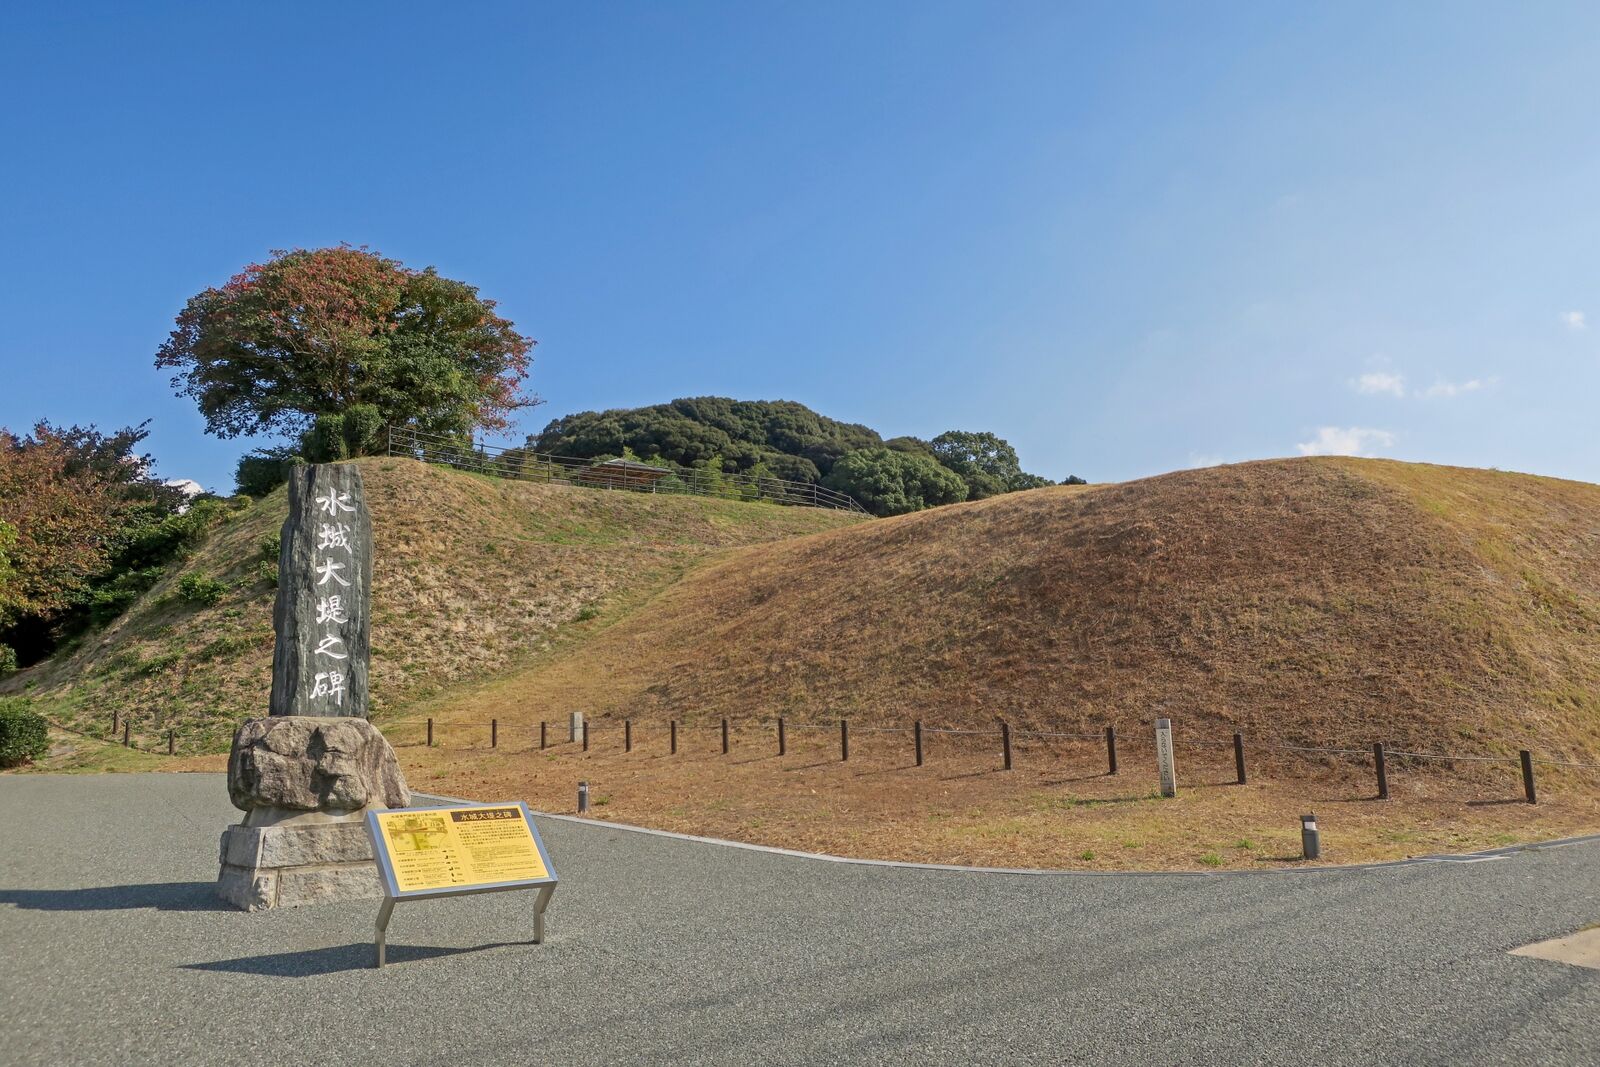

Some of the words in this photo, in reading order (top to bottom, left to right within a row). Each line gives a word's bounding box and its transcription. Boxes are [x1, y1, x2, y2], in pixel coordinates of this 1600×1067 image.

[309, 486, 357, 706] 水城大堤之碑
